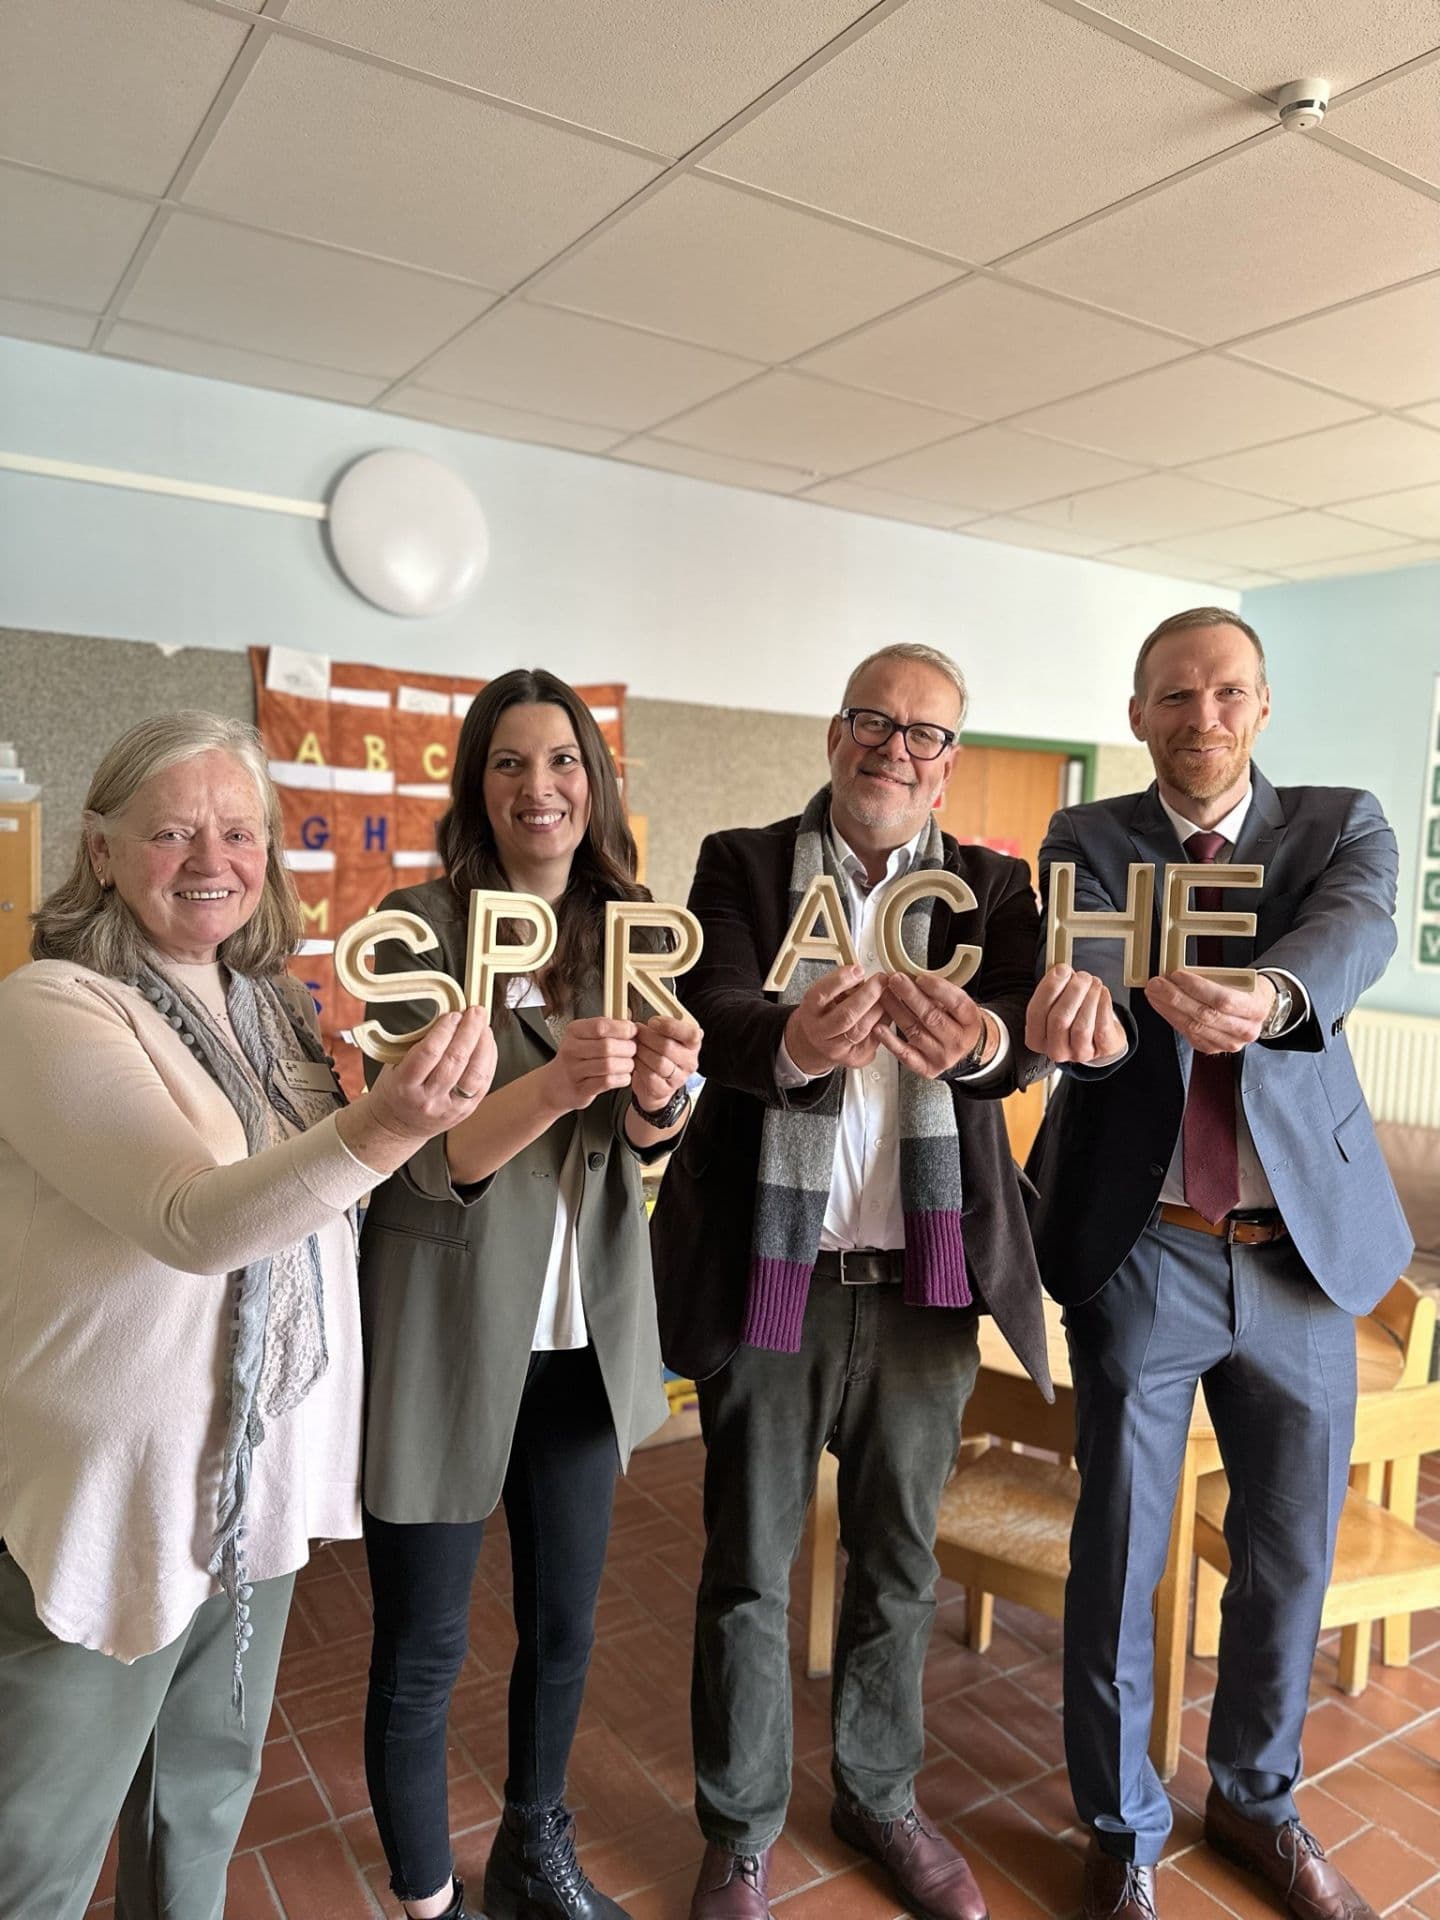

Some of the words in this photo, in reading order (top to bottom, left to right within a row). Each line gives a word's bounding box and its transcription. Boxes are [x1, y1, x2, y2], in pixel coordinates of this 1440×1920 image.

[296, 731, 325, 766] A
[363, 735, 389, 771] B
[422, 743, 448, 779] C
[301, 815, 330, 850] G
[364, 816, 387, 852] H
[299, 898, 329, 933] M
